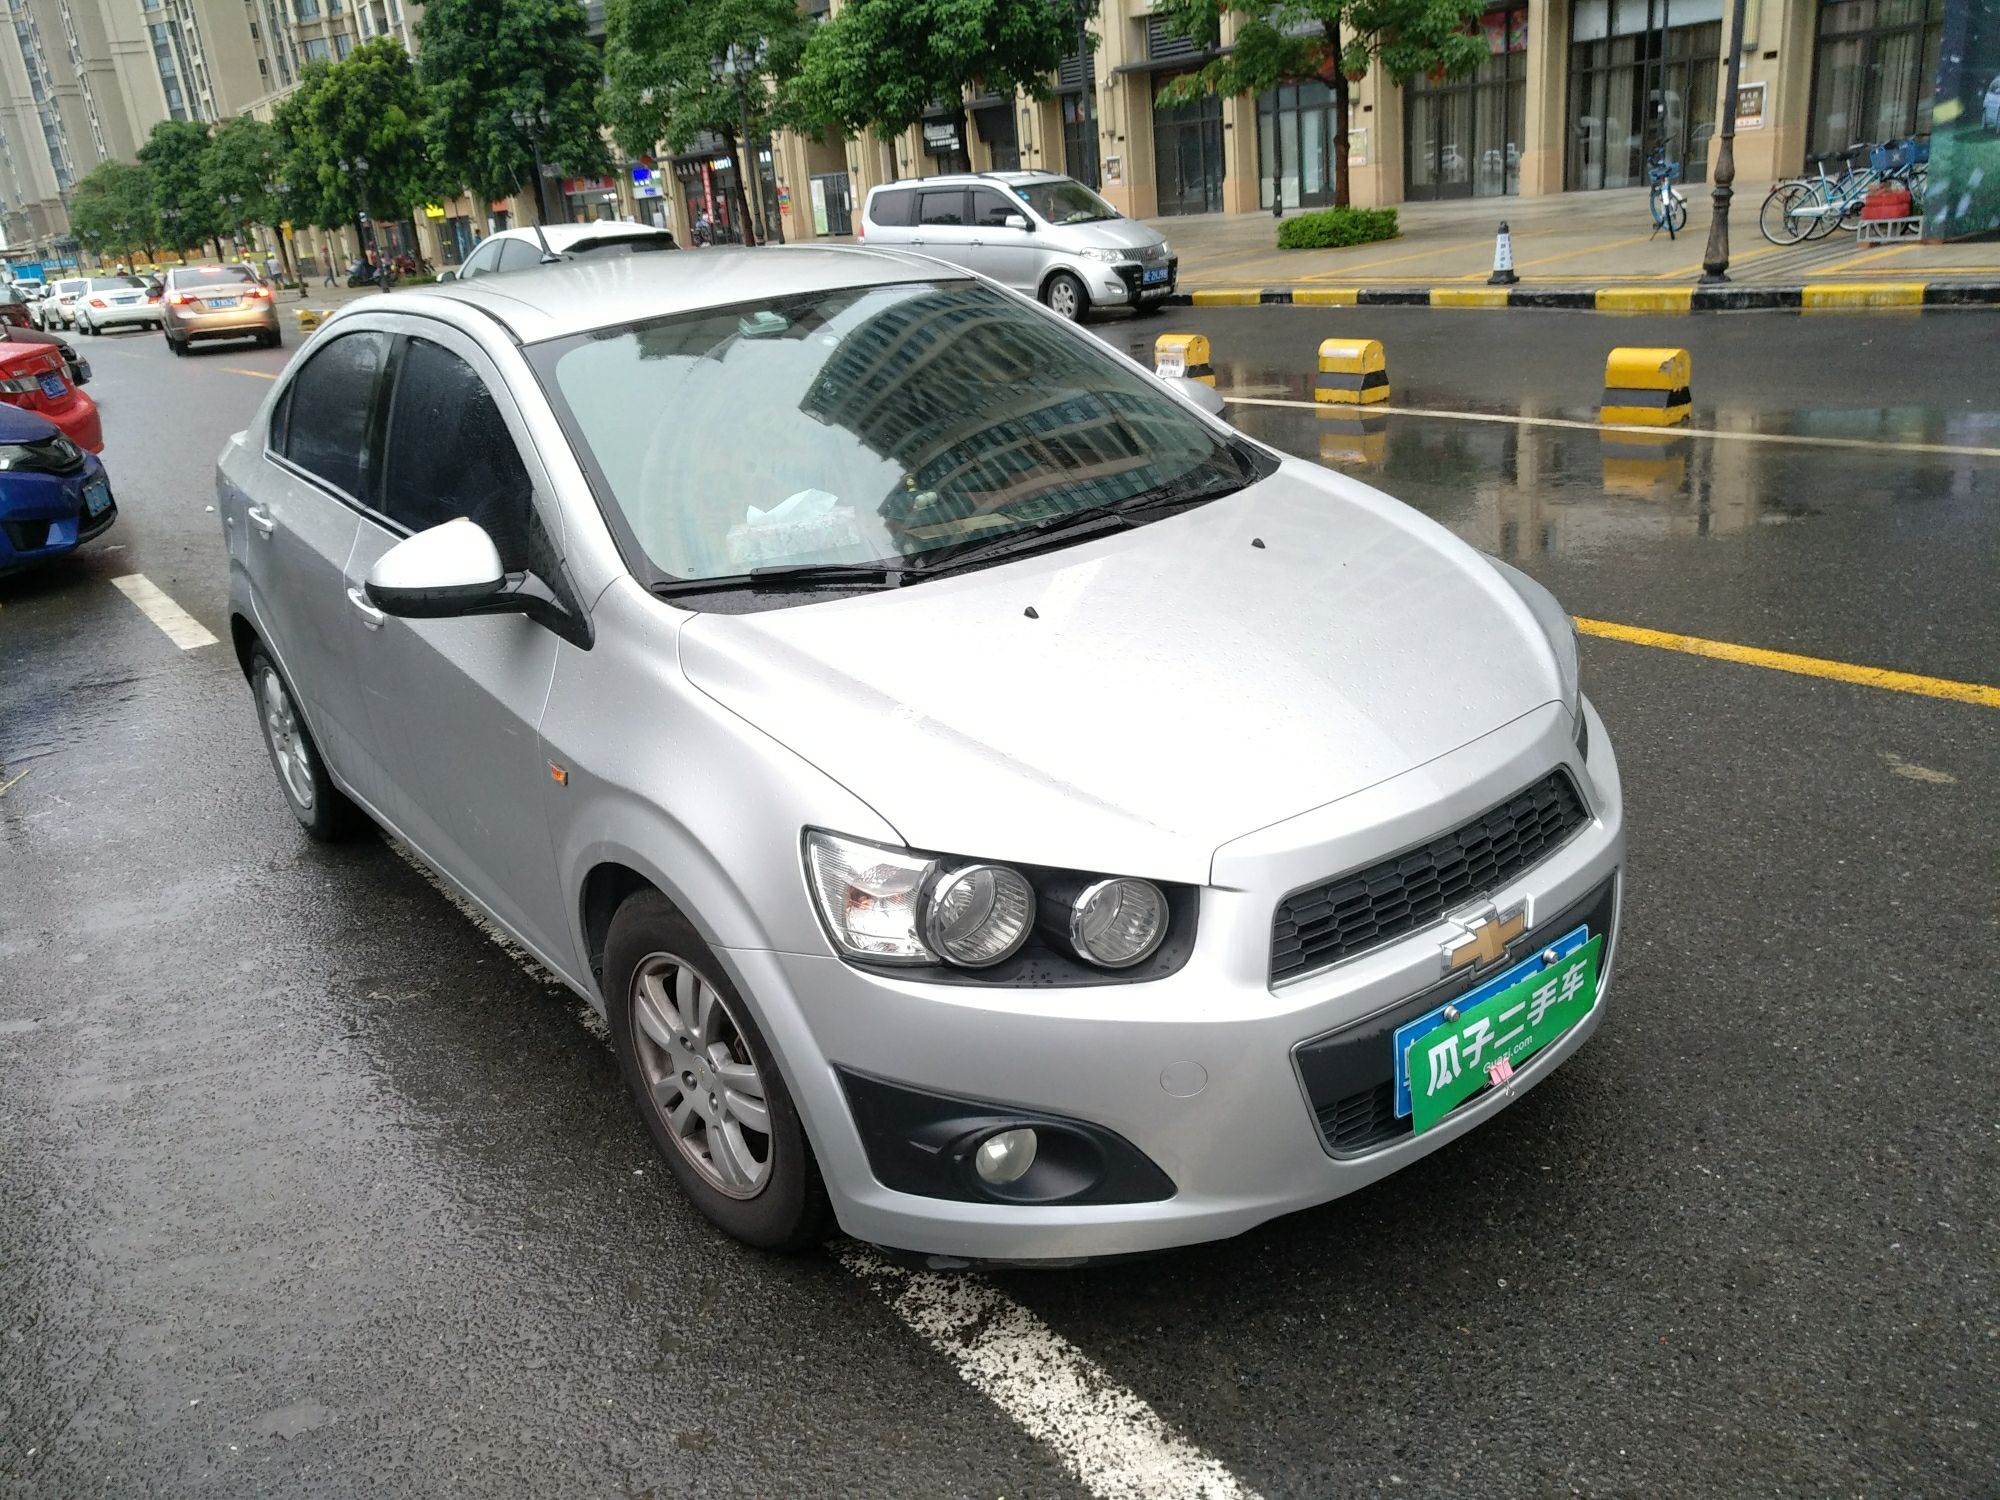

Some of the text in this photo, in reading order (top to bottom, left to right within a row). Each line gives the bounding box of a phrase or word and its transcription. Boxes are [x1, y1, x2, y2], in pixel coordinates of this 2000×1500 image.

[1427, 959, 1587, 1096] 瓜子二手车
